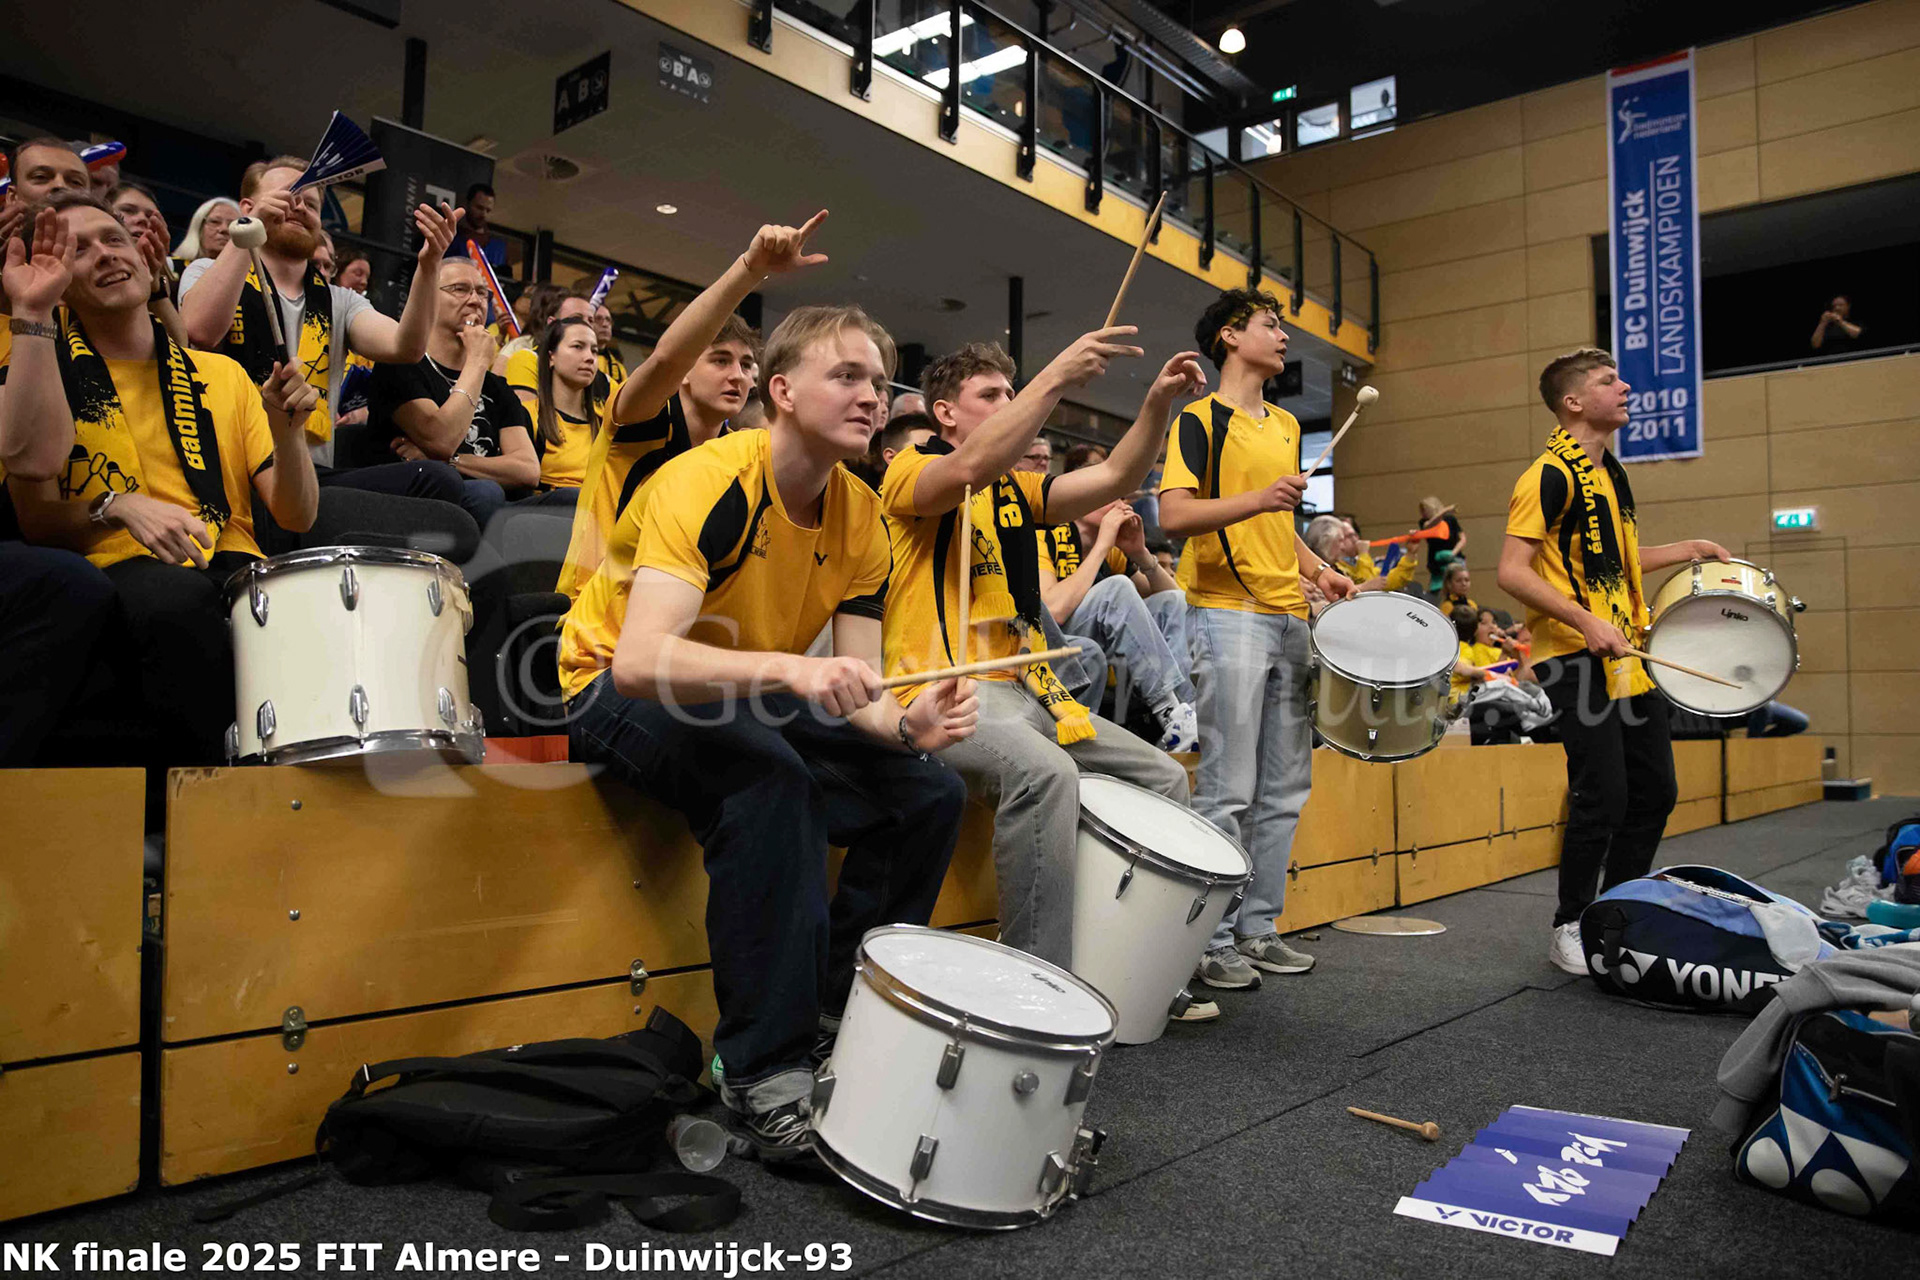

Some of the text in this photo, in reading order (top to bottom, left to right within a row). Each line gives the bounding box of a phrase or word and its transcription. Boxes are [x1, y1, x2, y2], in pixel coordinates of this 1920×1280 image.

[1634, 122, 1682, 140] nederland
[1622, 188, 1650, 350] BC Duinwijck
[1656, 155, 1686, 375] LANDSKAMPIOEN
[1628, 387, 1688, 413] 2010
[1628, 416, 1686, 442] 2011
[1572, 463, 1596, 512] voor
[1667, 957, 1792, 1001] YON
[1470, 1212, 1574, 1243] VICTOR
